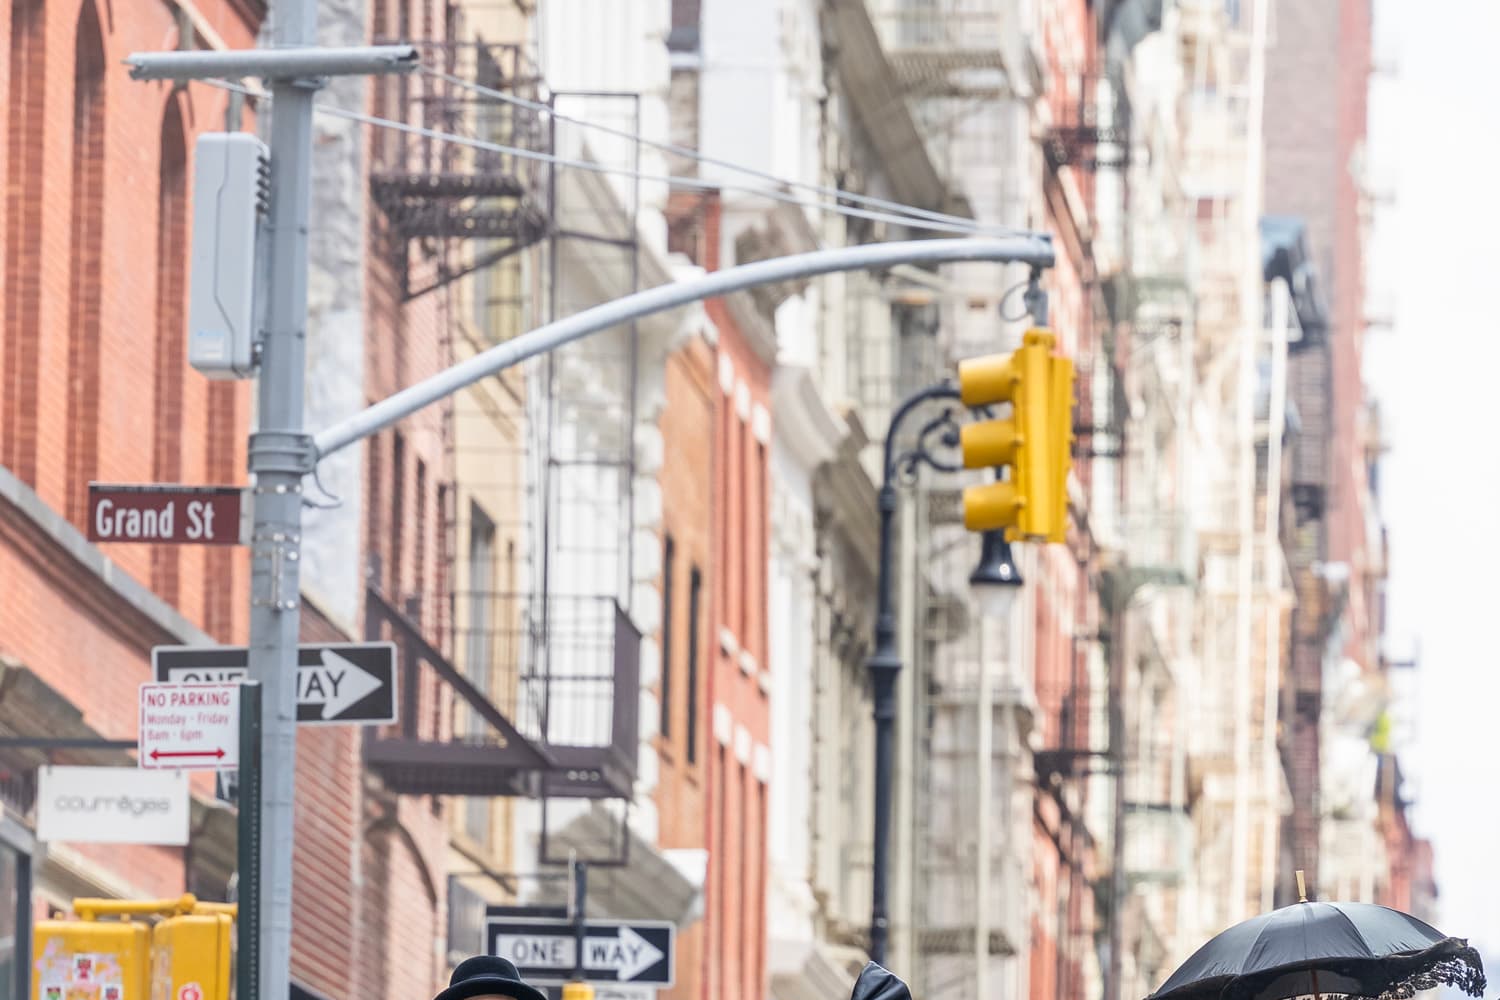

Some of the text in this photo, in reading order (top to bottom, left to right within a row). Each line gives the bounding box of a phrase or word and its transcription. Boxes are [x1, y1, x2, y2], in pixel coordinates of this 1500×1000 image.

[95, 499, 215, 539] Grand St
[297, 670, 346, 698] AY
[147, 691, 230, 707] NO PARKING
[147, 713, 186, 726] Monday
[197, 711, 229, 726] Friday
[511, 939, 642, 965] ONE WAY
